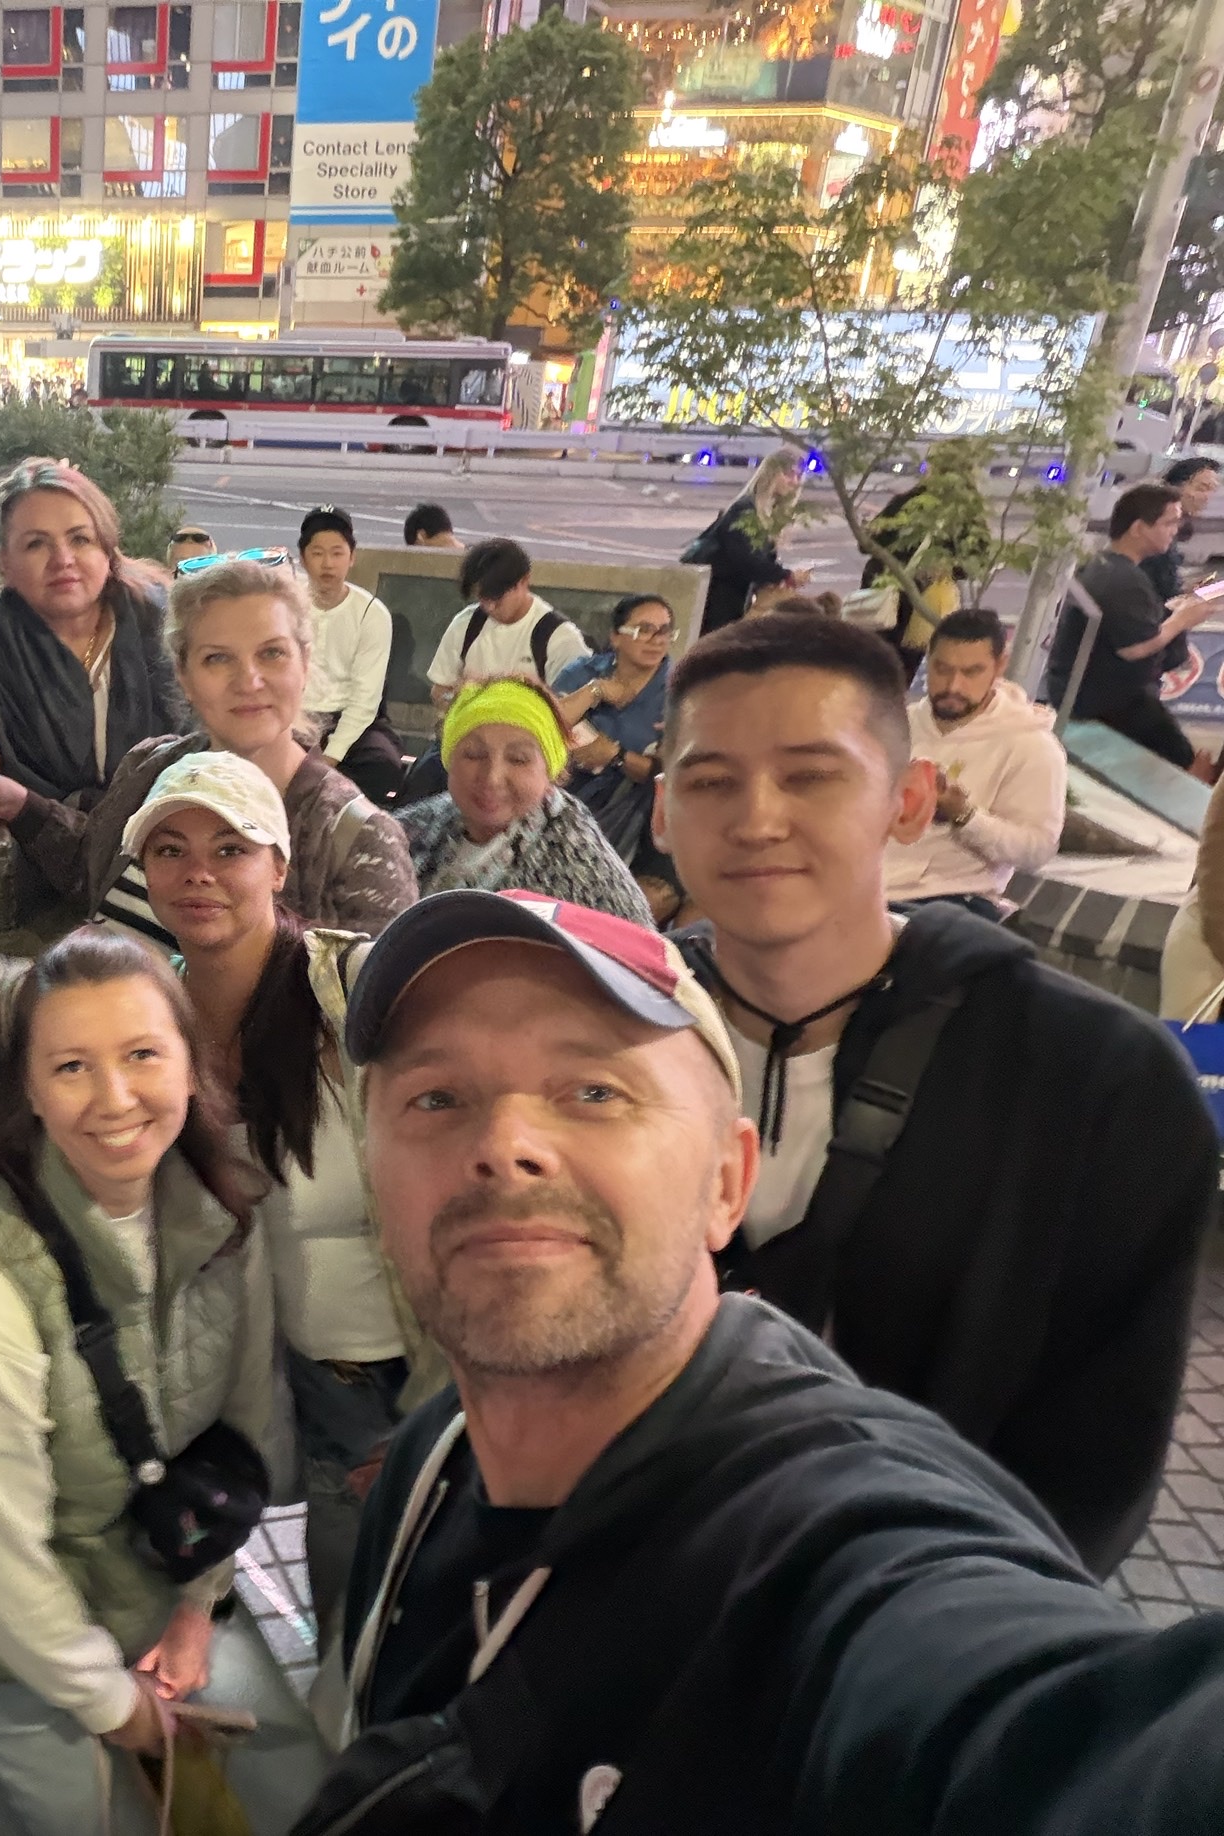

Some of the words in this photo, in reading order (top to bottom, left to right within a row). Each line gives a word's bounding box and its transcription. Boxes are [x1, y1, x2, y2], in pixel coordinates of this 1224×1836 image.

[377, 0, 418, 60] の
[303, 140, 368, 156] Contact
[317, 162, 398, 179] Speciality
[333, 184, 377, 199] Store
